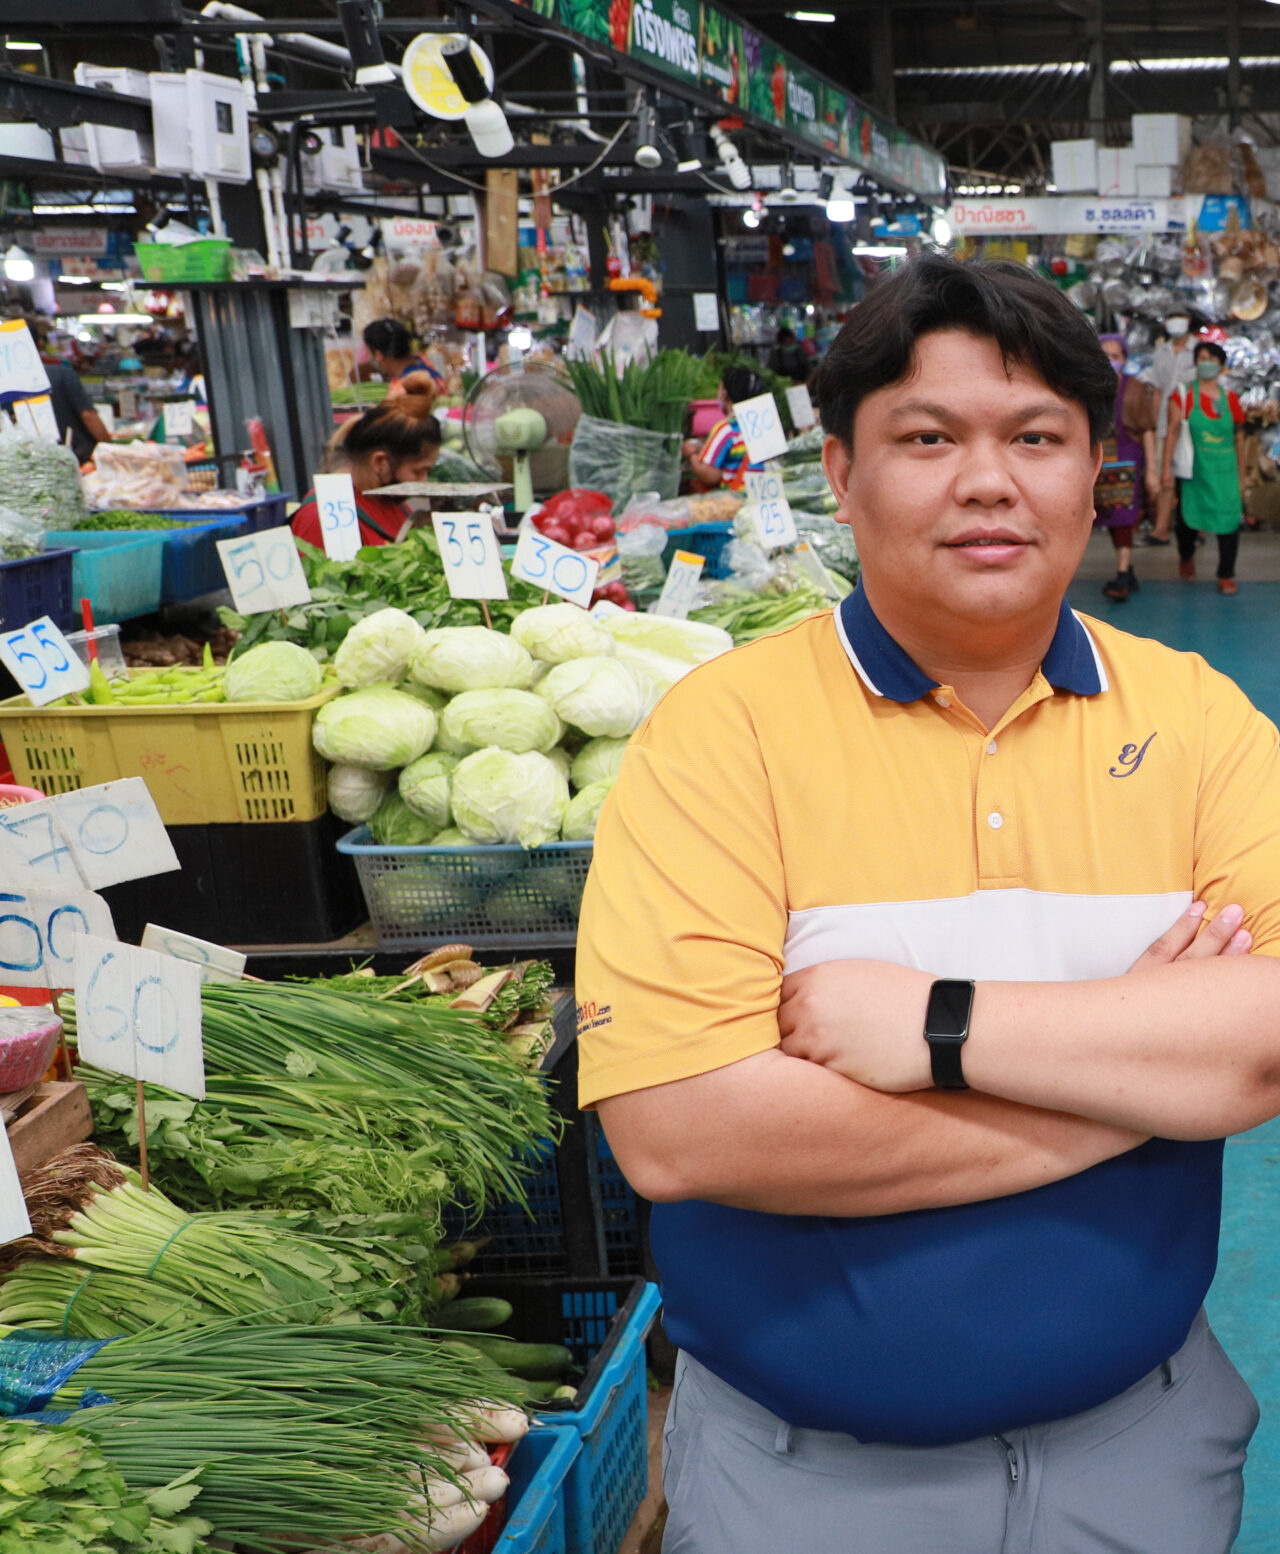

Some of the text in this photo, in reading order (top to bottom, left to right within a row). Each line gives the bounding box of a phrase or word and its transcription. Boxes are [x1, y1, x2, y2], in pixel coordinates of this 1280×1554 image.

[322, 500, 357, 532] 35
[441, 520, 486, 568] 35
[760, 501, 786, 535] 25
[227, 540, 295, 600] 50
[521, 535, 588, 593] 30
[6, 623, 70, 690] 55
[86, 951, 181, 1055] 60
